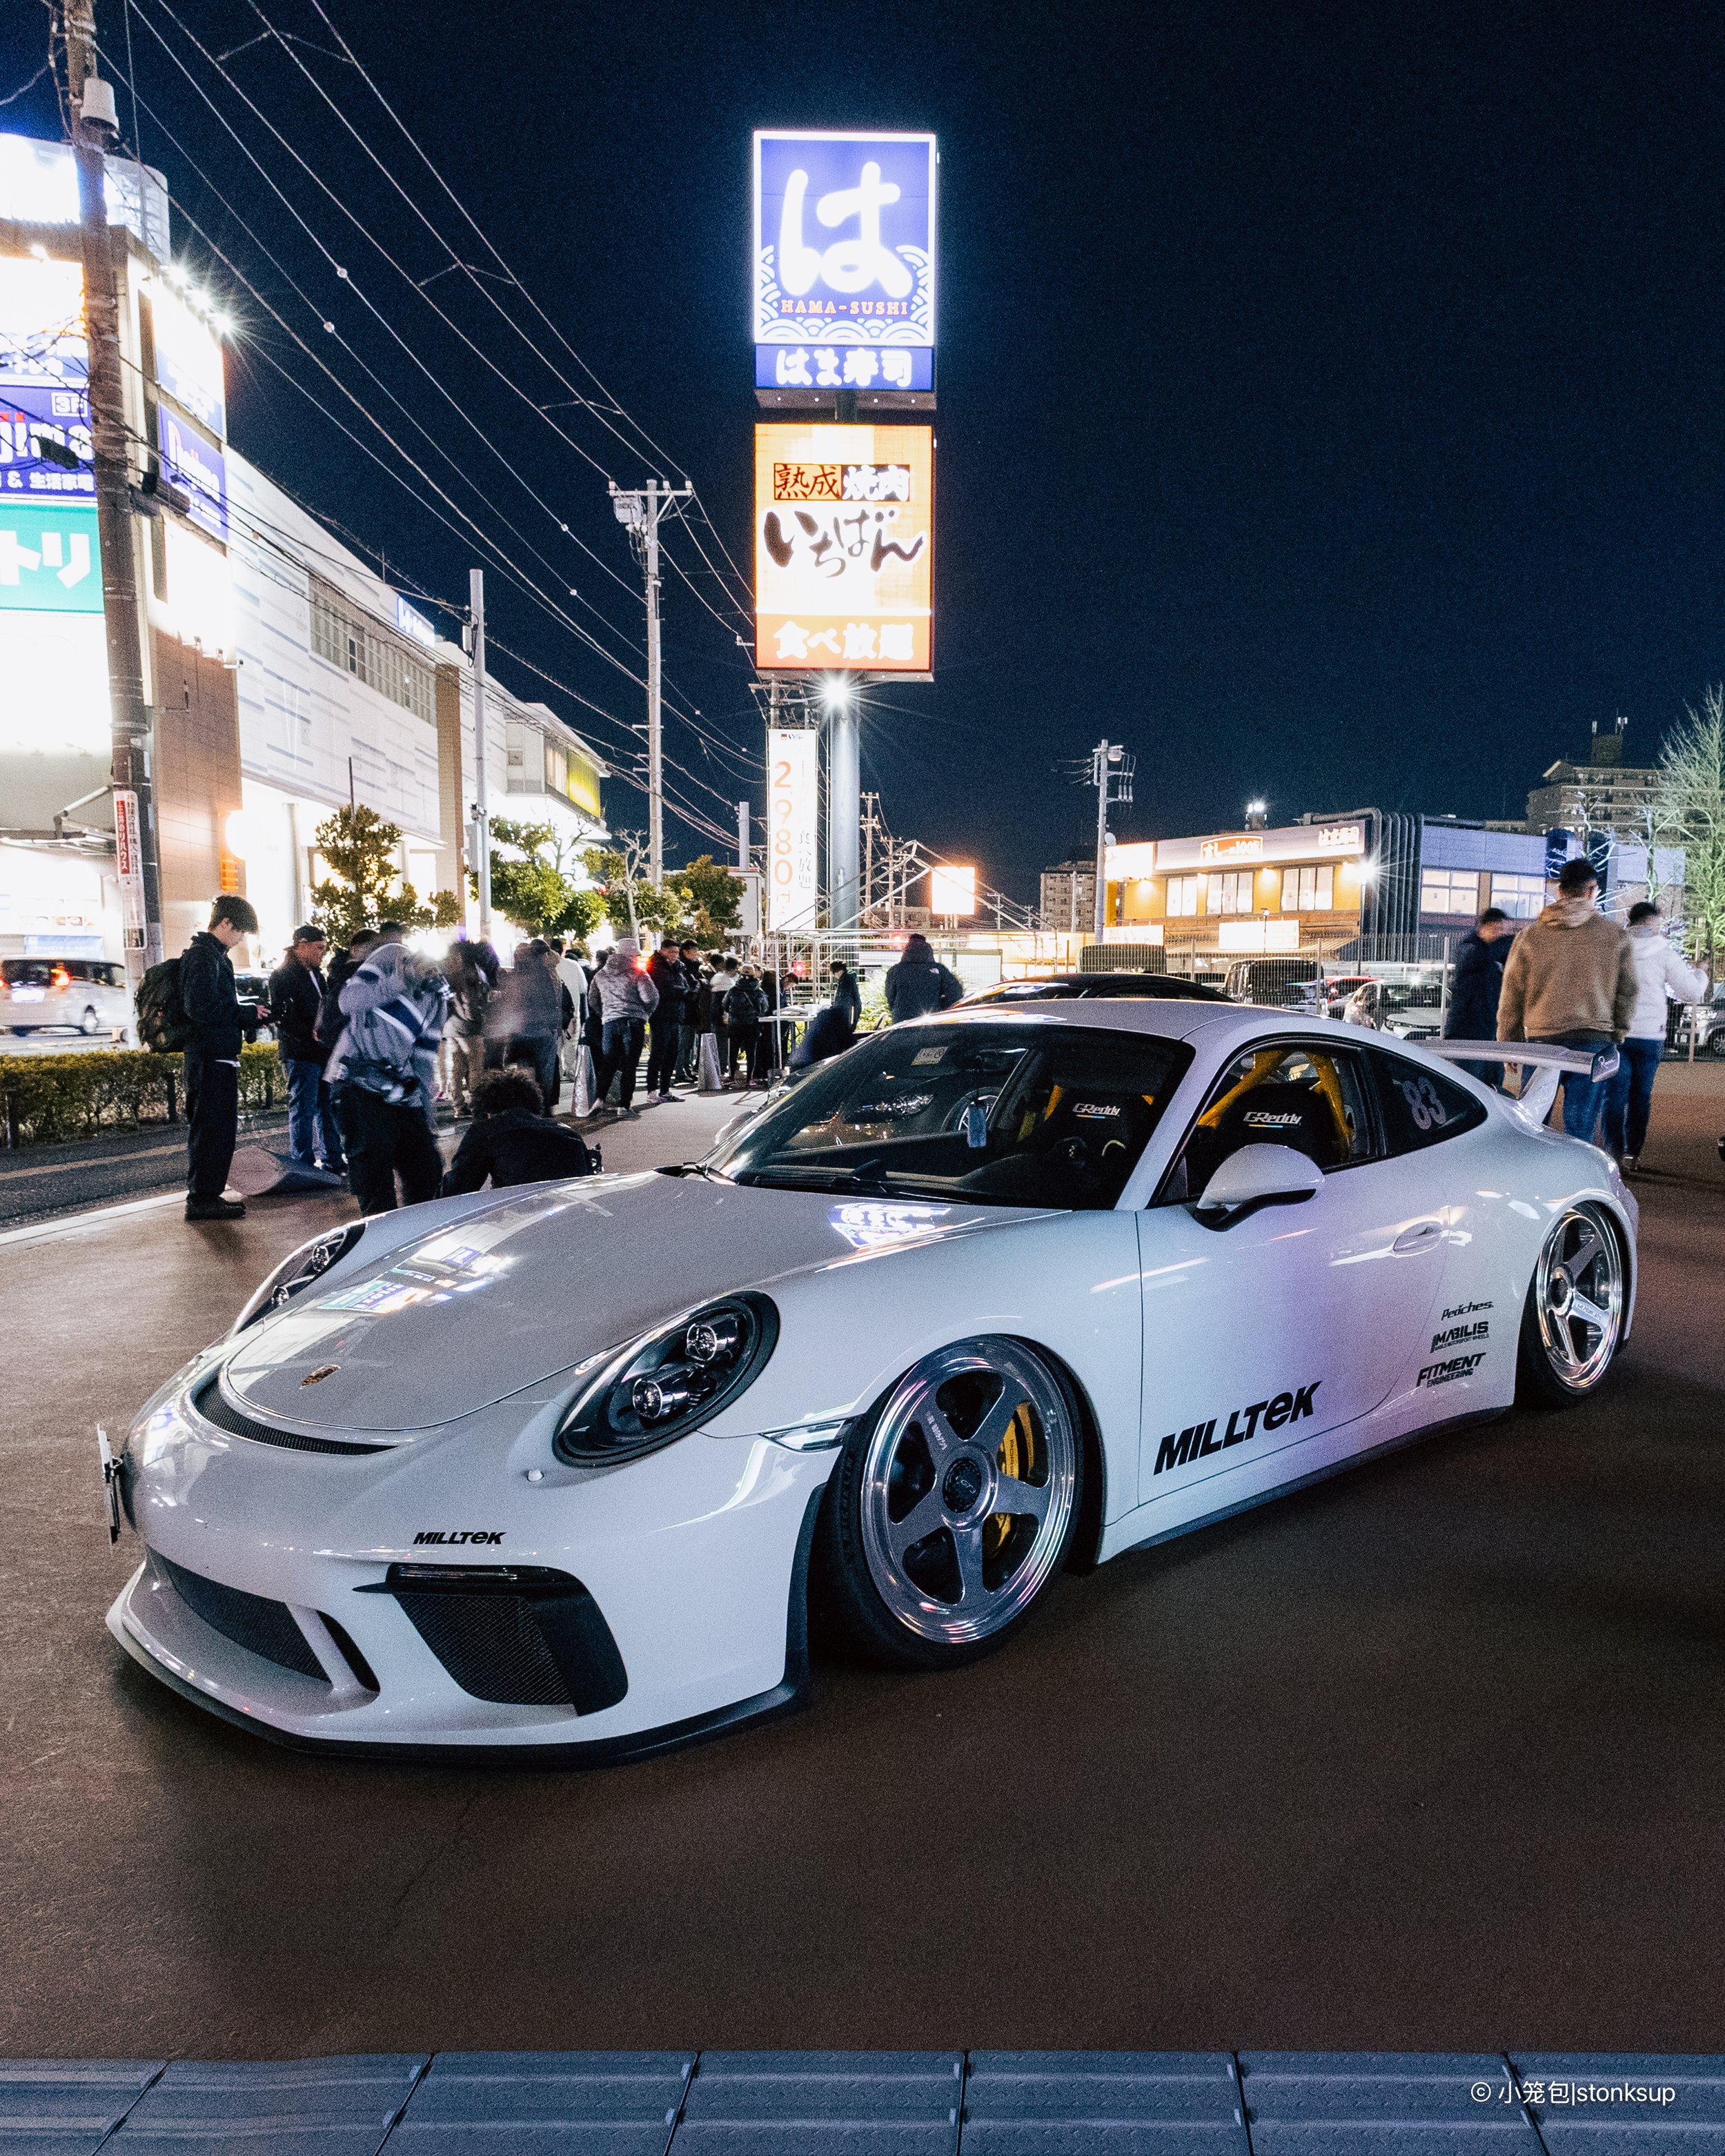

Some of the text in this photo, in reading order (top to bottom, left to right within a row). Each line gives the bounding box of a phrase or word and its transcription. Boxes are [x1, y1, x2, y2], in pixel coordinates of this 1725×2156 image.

[779, 161, 913, 299] は
[780, 299, 908, 315] HAMA-SUSHI
[776, 347, 912, 387] はま寿司
[763, 508, 924, 578] いちばん
[1072, 1103, 1121, 1116] GReddy
[1243, 1111, 1302, 1125] GReddy
[1402, 1077, 1446, 1130] 83
[1416, 1352, 1486, 1387] FITMENT
[1426, 1368, 1474, 1388] ENGINEERING
